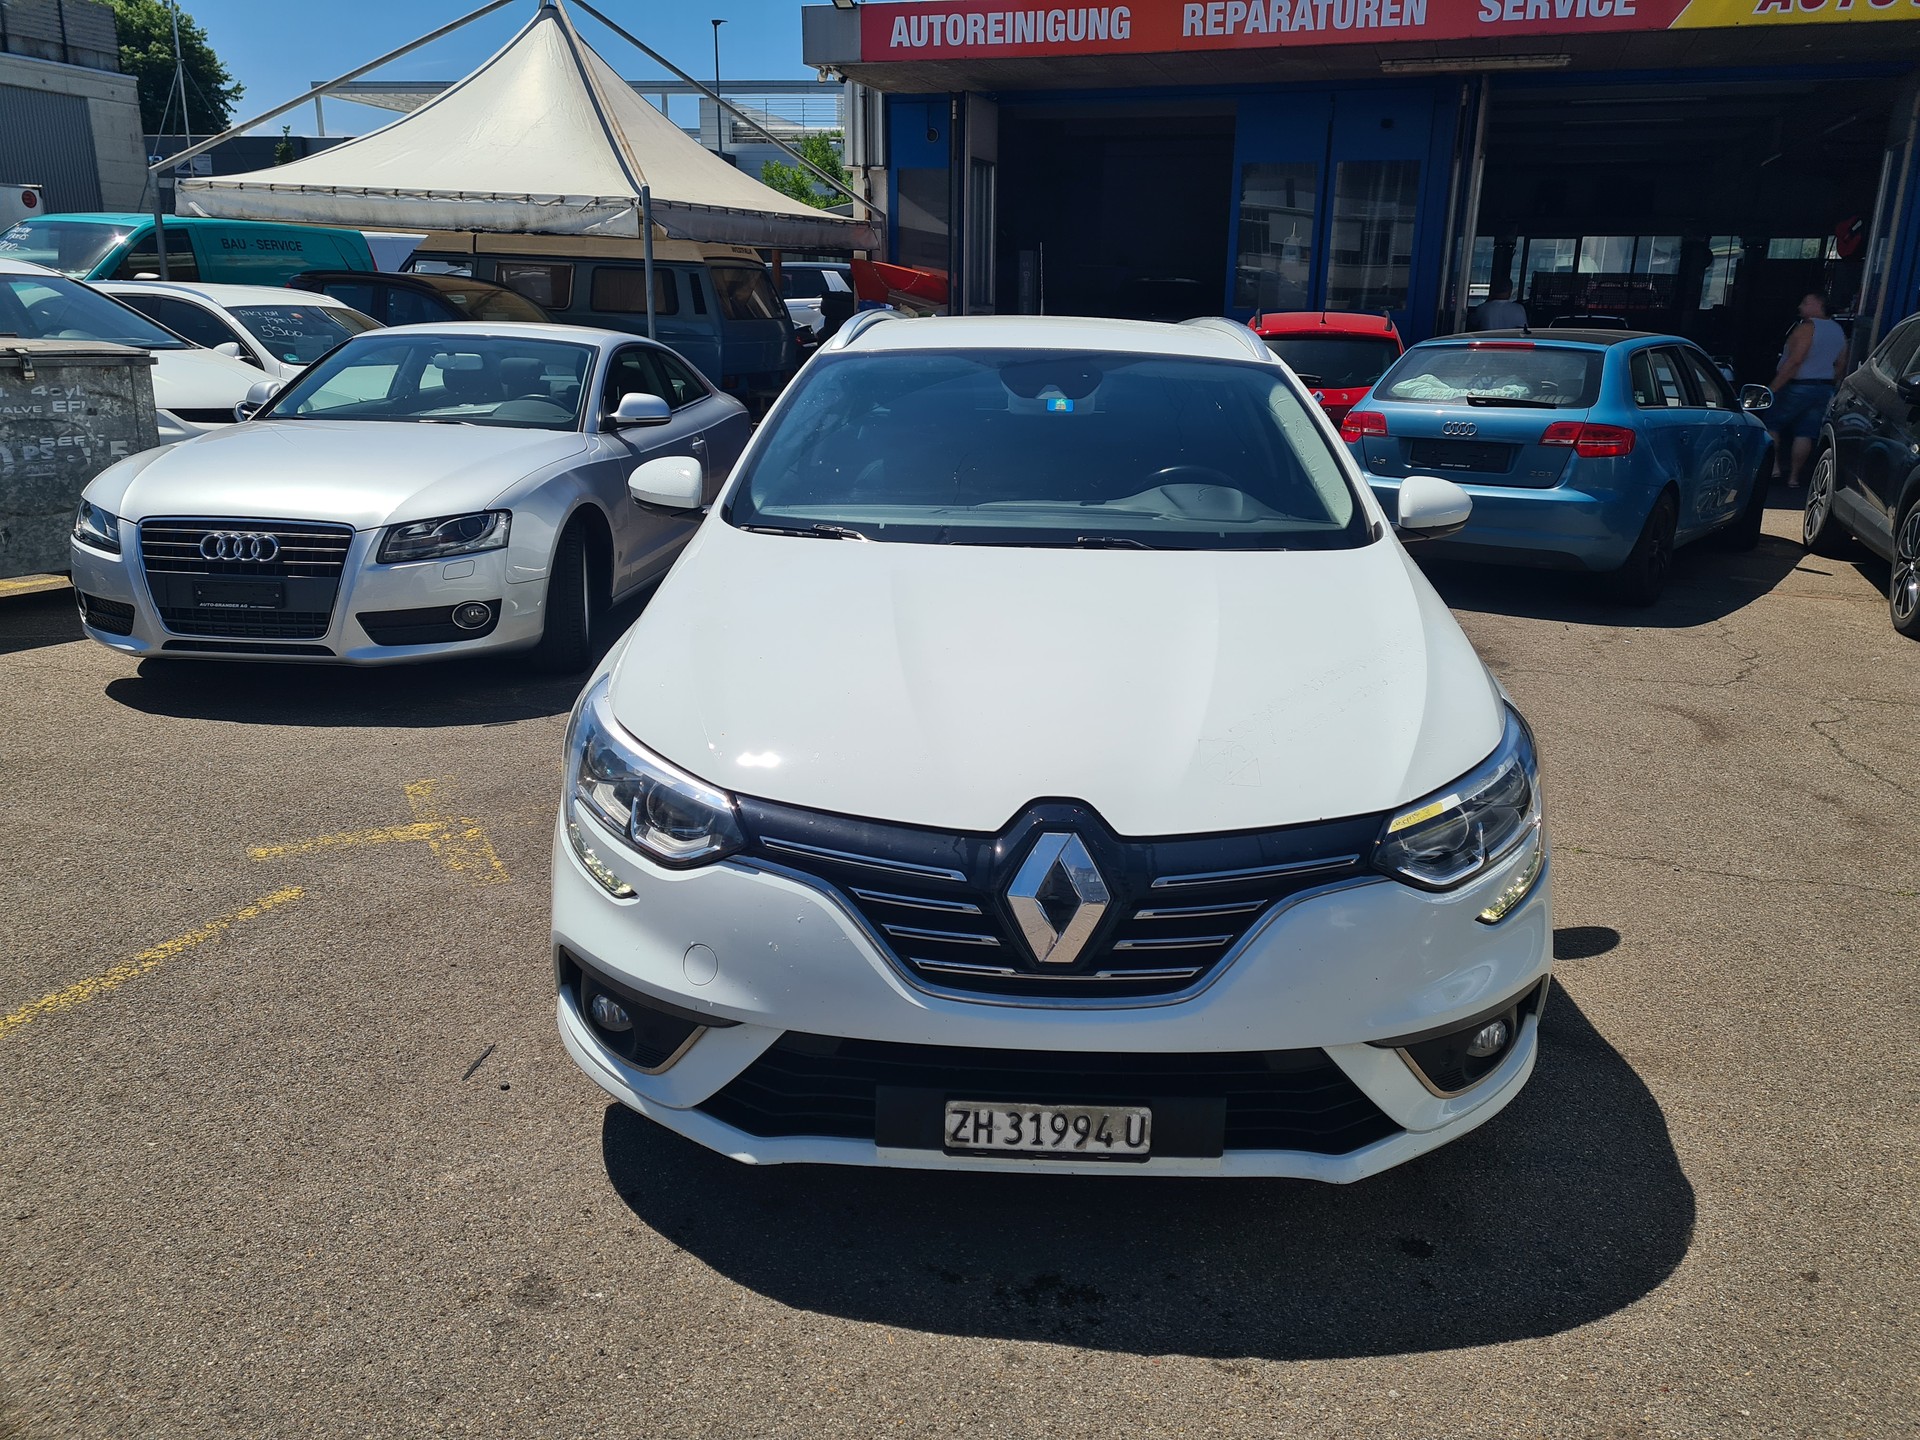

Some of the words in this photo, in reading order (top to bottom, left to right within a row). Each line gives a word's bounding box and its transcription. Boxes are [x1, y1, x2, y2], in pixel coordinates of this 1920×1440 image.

[889, 8, 1131, 48] AUTOREINIGUNG
[1182, 0, 1428, 37] REPARATUREN
[221, 238, 247, 250] BAU
[256, 239, 304, 252] SERVICE
[0, 405, 43, 414] ALVE
[952, 1110, 993, 1144] ZH
[1004, 1112, 1113, 1148] 31994
[1126, 1115, 1146, 1148] U
